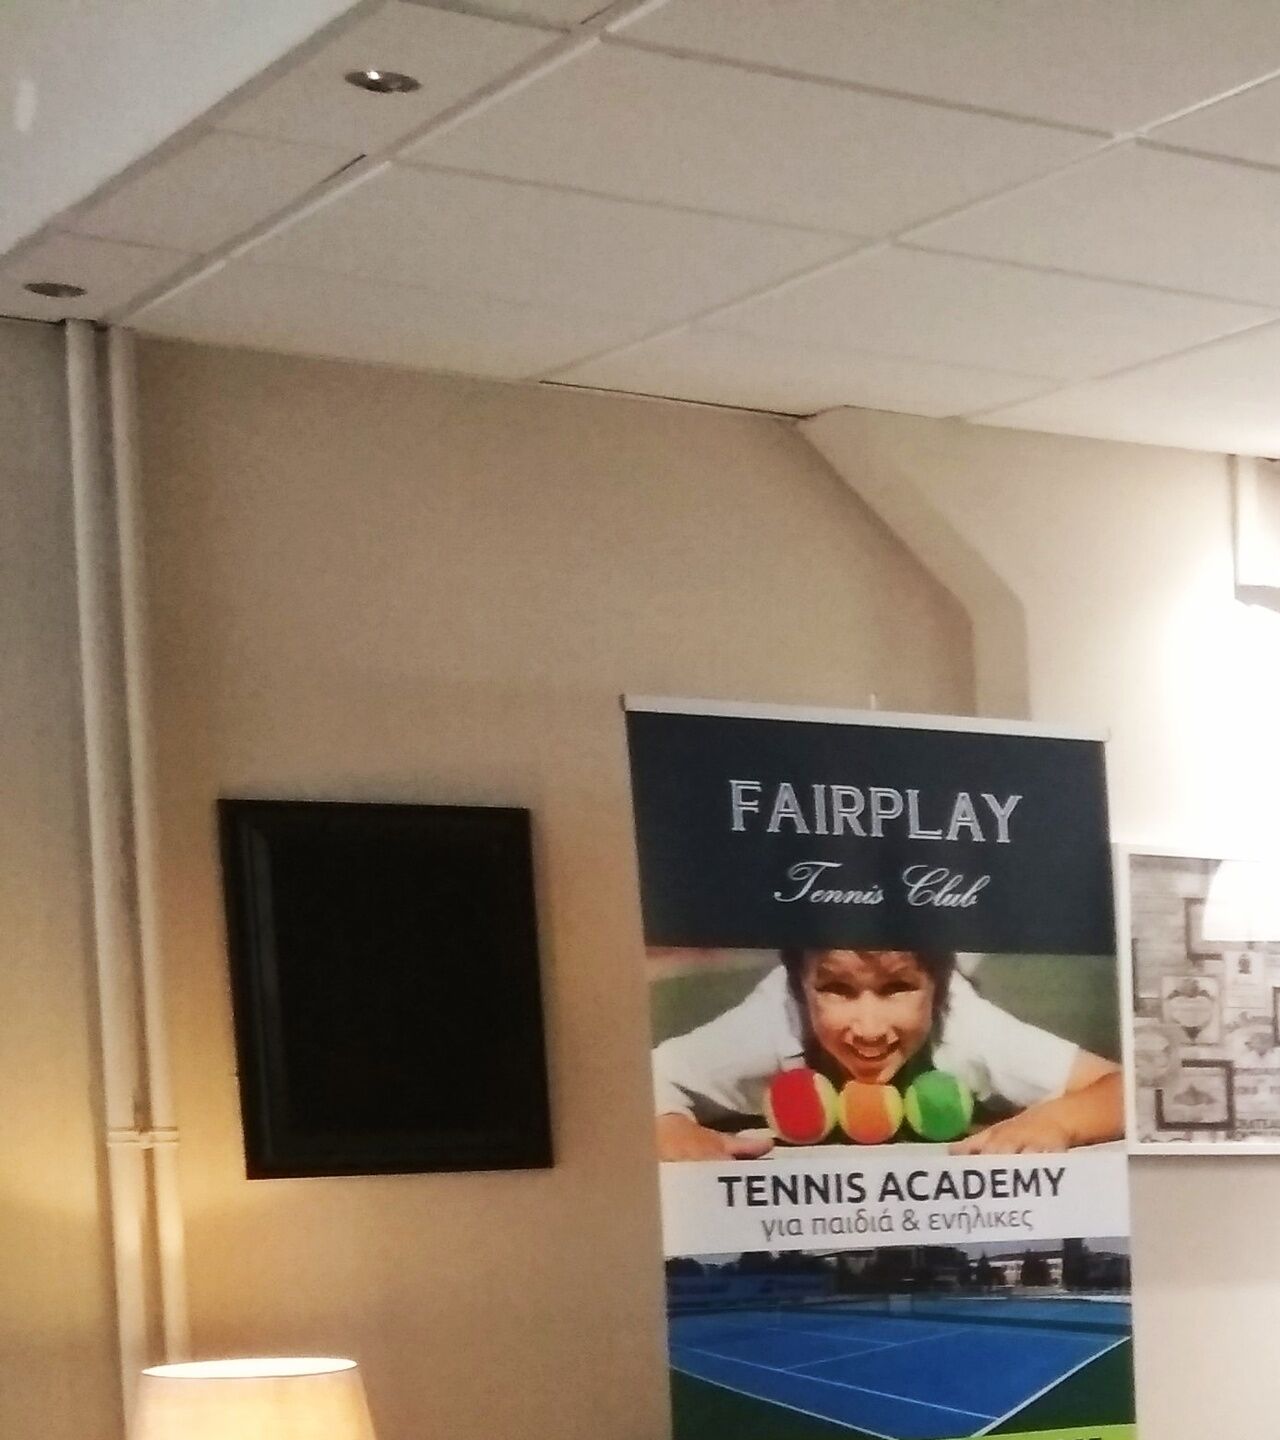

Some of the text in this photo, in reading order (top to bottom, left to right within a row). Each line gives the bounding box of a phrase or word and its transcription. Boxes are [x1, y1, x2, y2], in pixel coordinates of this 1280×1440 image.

[729, 779, 1023, 844] FAIRPLAY
[773, 861, 991, 909] Tennis Club
[718, 1166, 1066, 1207] TENNIS ACADEMY
[761, 1205, 1033, 1242] για παιδιά & ενήλικες
